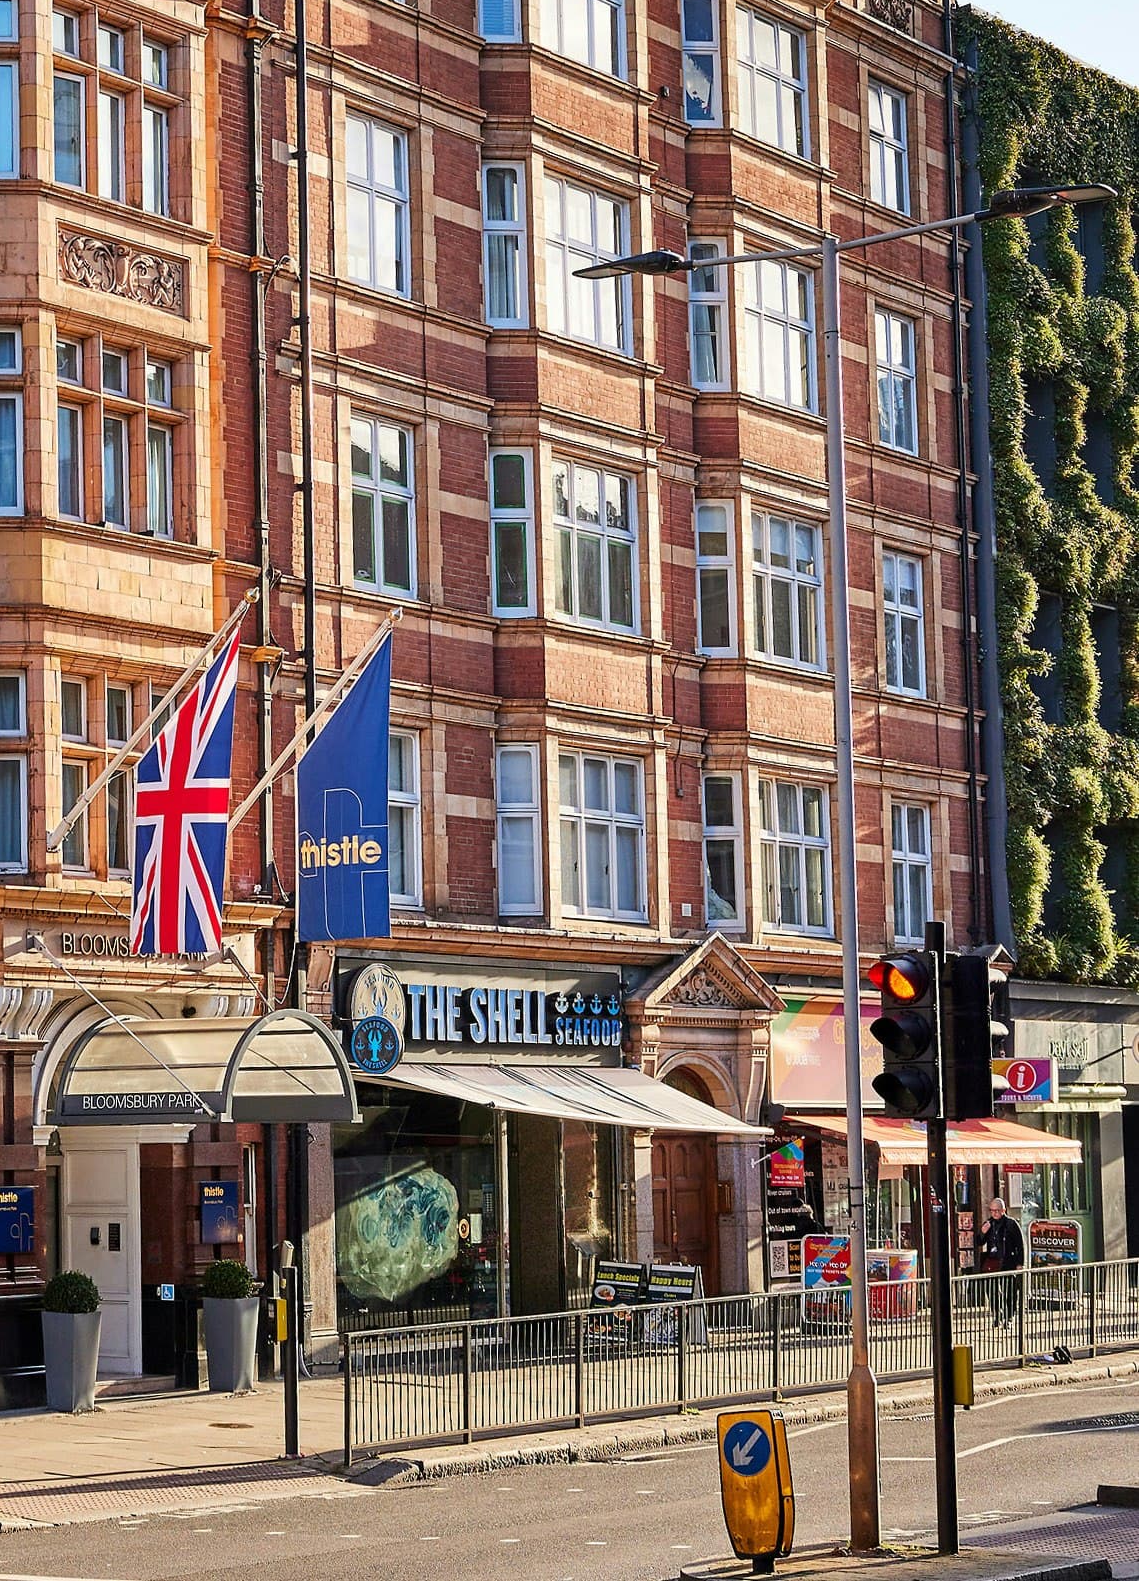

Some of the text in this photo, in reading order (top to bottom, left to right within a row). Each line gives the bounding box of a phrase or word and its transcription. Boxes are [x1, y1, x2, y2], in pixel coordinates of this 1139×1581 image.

[301, 835, 382, 869] thistle
[62, 932, 166, 961] BLOOMS
[407, 983, 553, 1045] THE SHELL
[555, 1016, 622, 1047] SEAFOOD
[82, 1093, 201, 1110] BLOOMSBURY PARK
[203, 1186, 224, 1197] thistle
[1032, 1236, 1075, 1247] DISCOVER
[597, 1271, 640, 1283] Lunch Specials
[650, 1276, 693, 1286] Happy Hours
